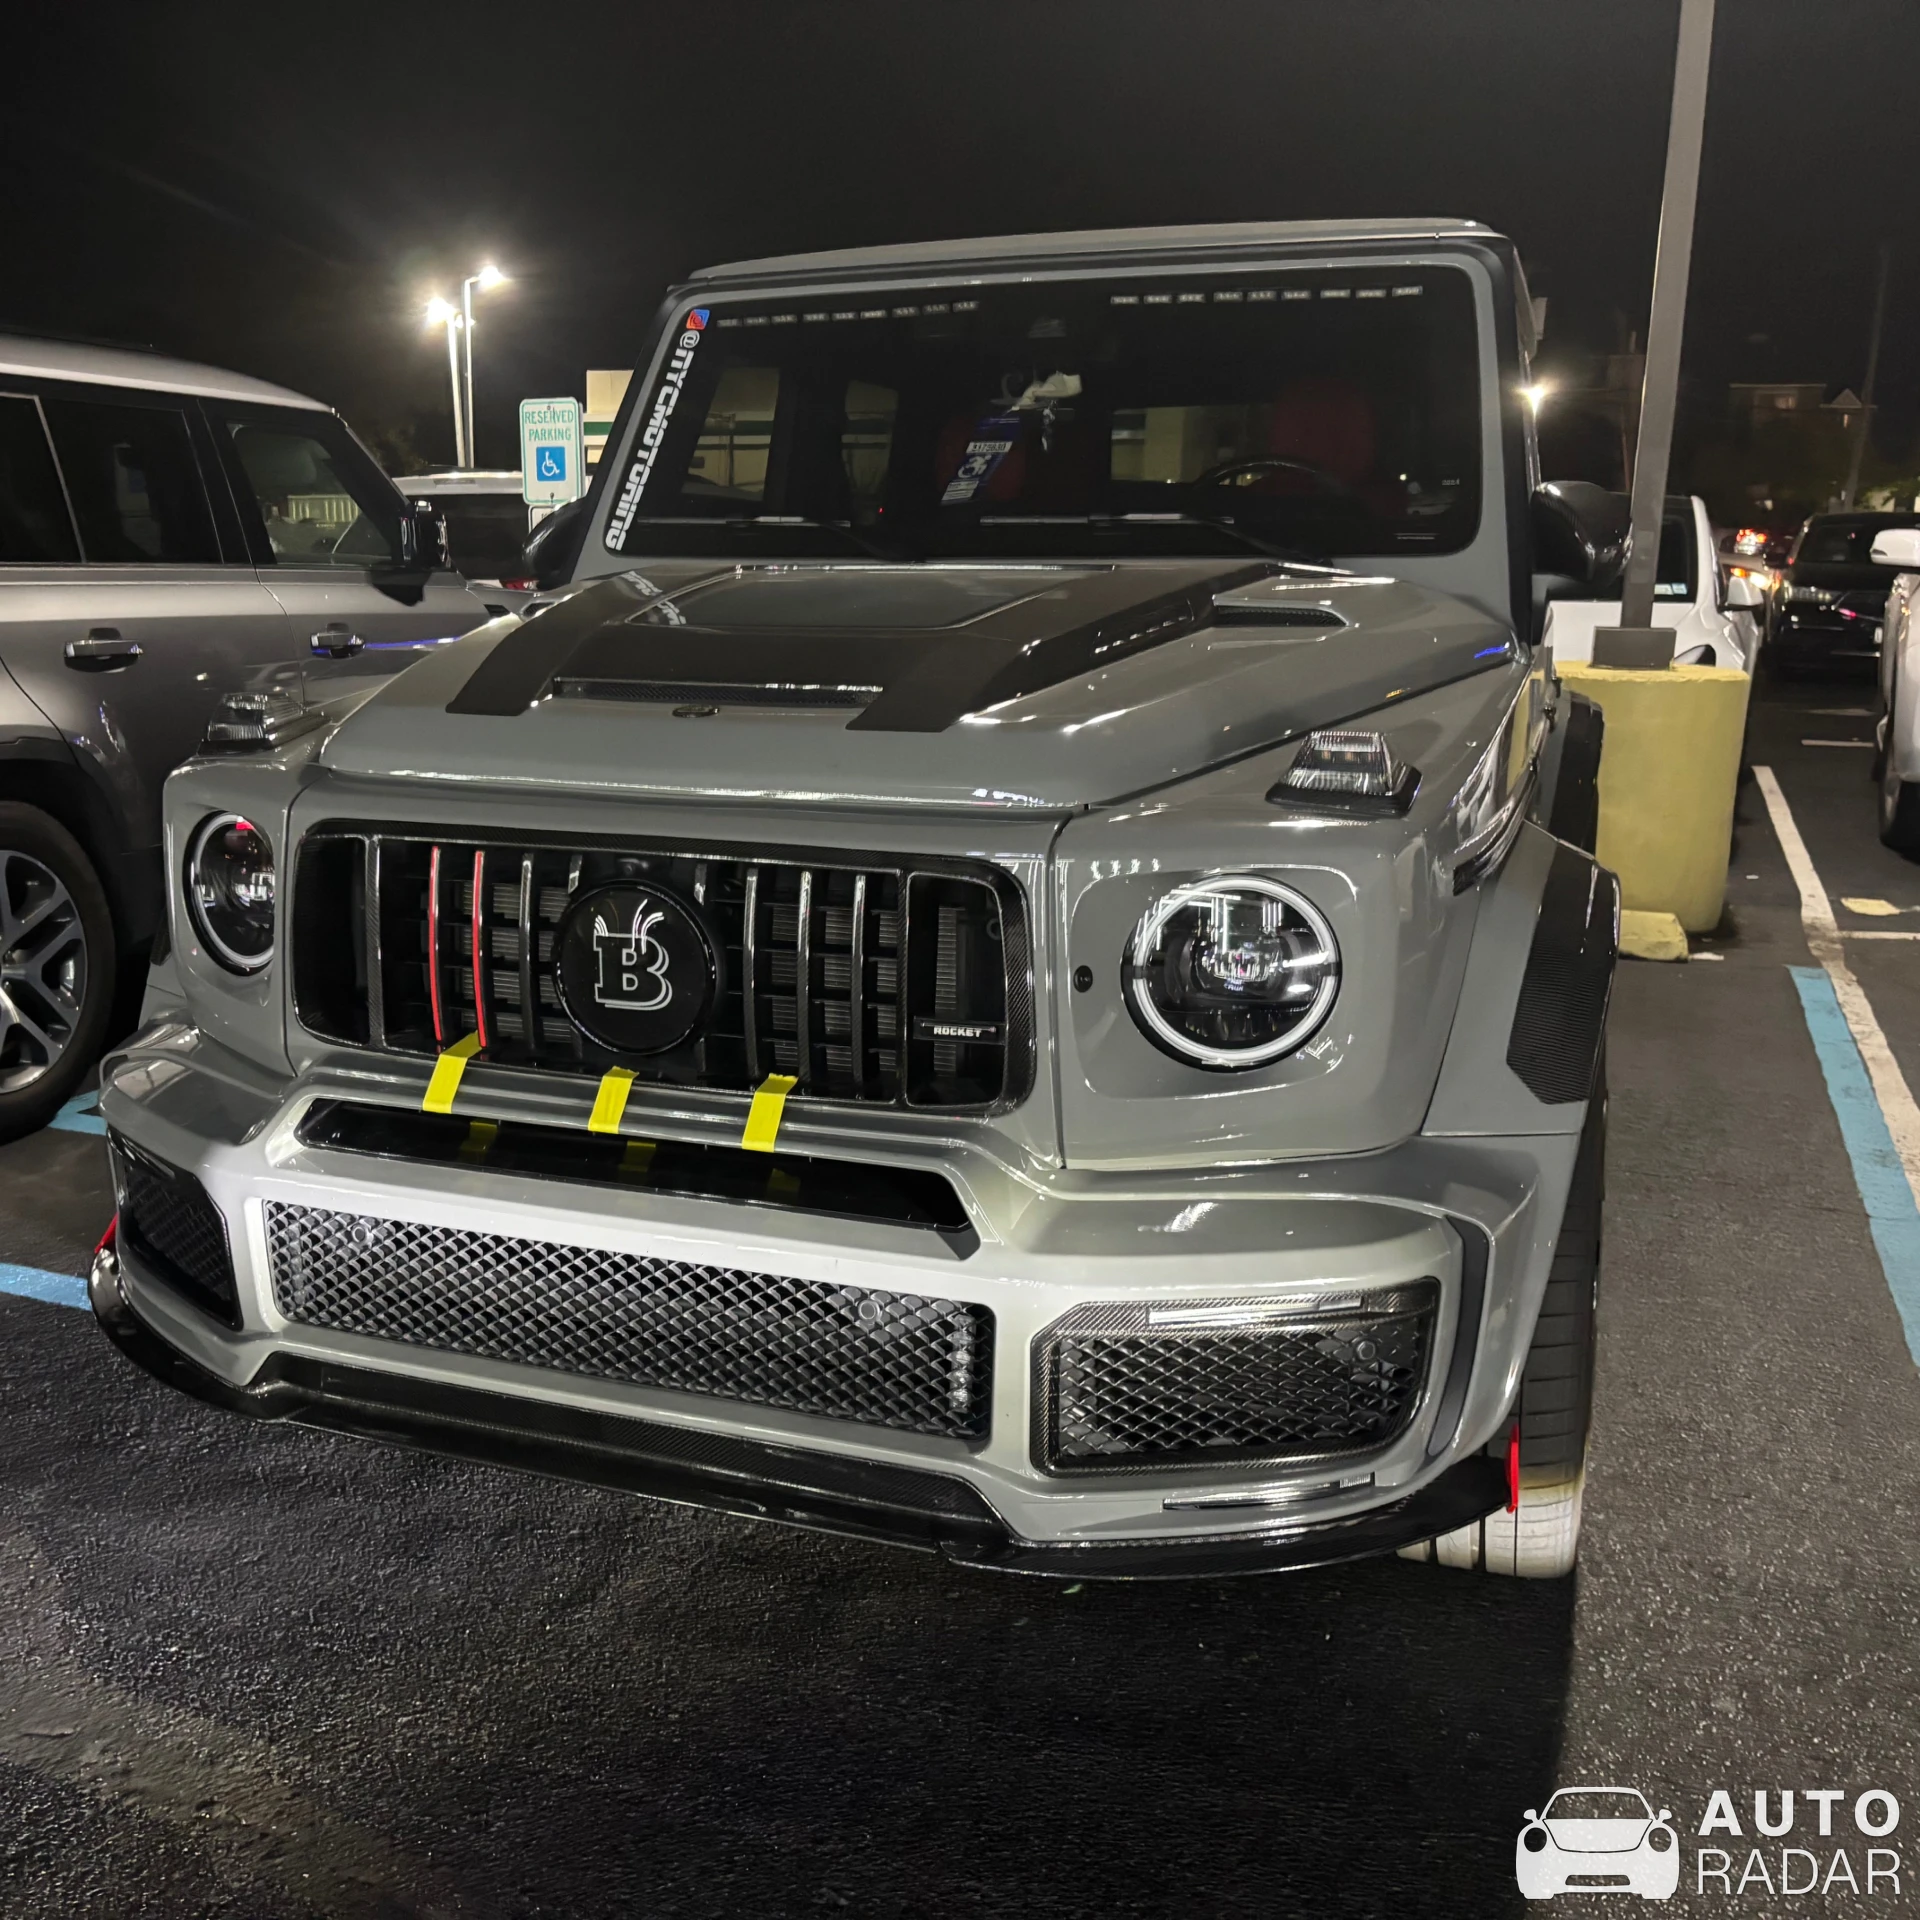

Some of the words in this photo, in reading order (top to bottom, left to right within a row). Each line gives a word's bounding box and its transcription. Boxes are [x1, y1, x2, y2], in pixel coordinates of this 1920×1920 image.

[525, 410, 574, 424] RESERVED
[529, 428, 571, 441] PARKING
[592, 932, 673, 1011] B
[933, 1026, 982, 1038] ROCKET
